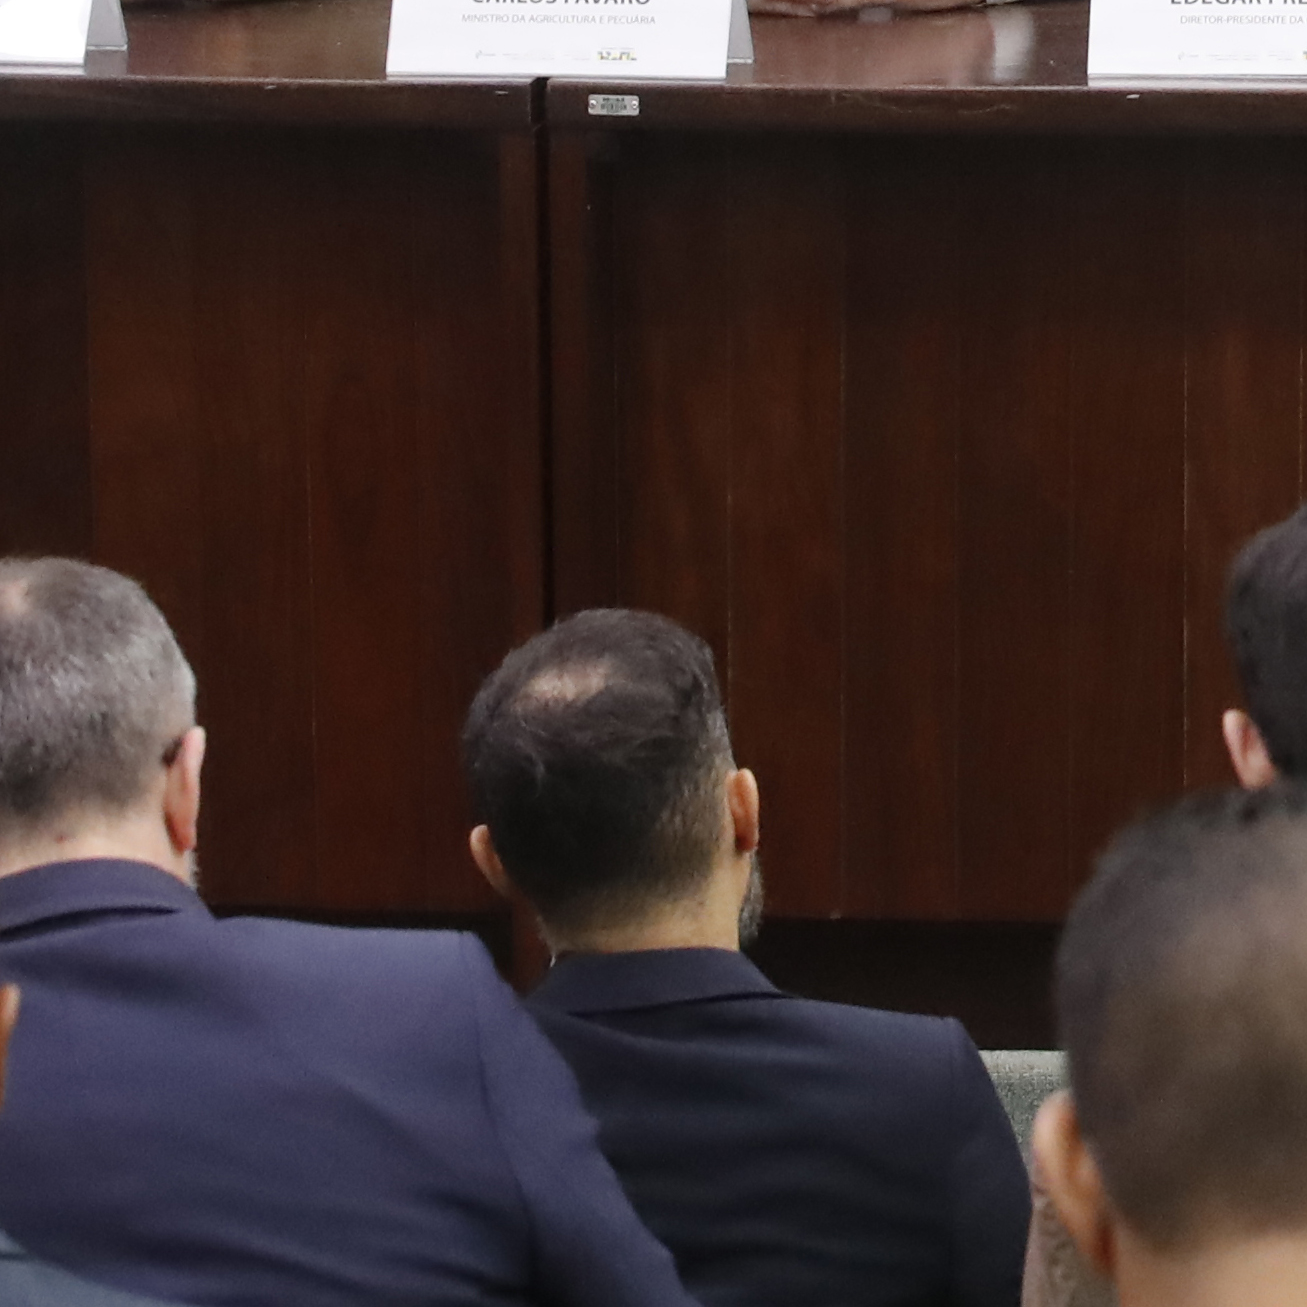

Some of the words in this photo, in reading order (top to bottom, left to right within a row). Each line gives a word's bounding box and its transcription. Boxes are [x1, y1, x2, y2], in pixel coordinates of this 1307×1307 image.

[461, 13, 510, 24] MINISTRO
[511, 13, 527, 24] DA
[528, 14, 597, 25] AGRICULTURA
[599, 14, 606, 25] E
[607, 13, 656, 25] PECUÁRIA
[1180, 14, 1287, 25] DIRETOR-PRESIDENTE
[1289, 15, 1305, 25] DA
